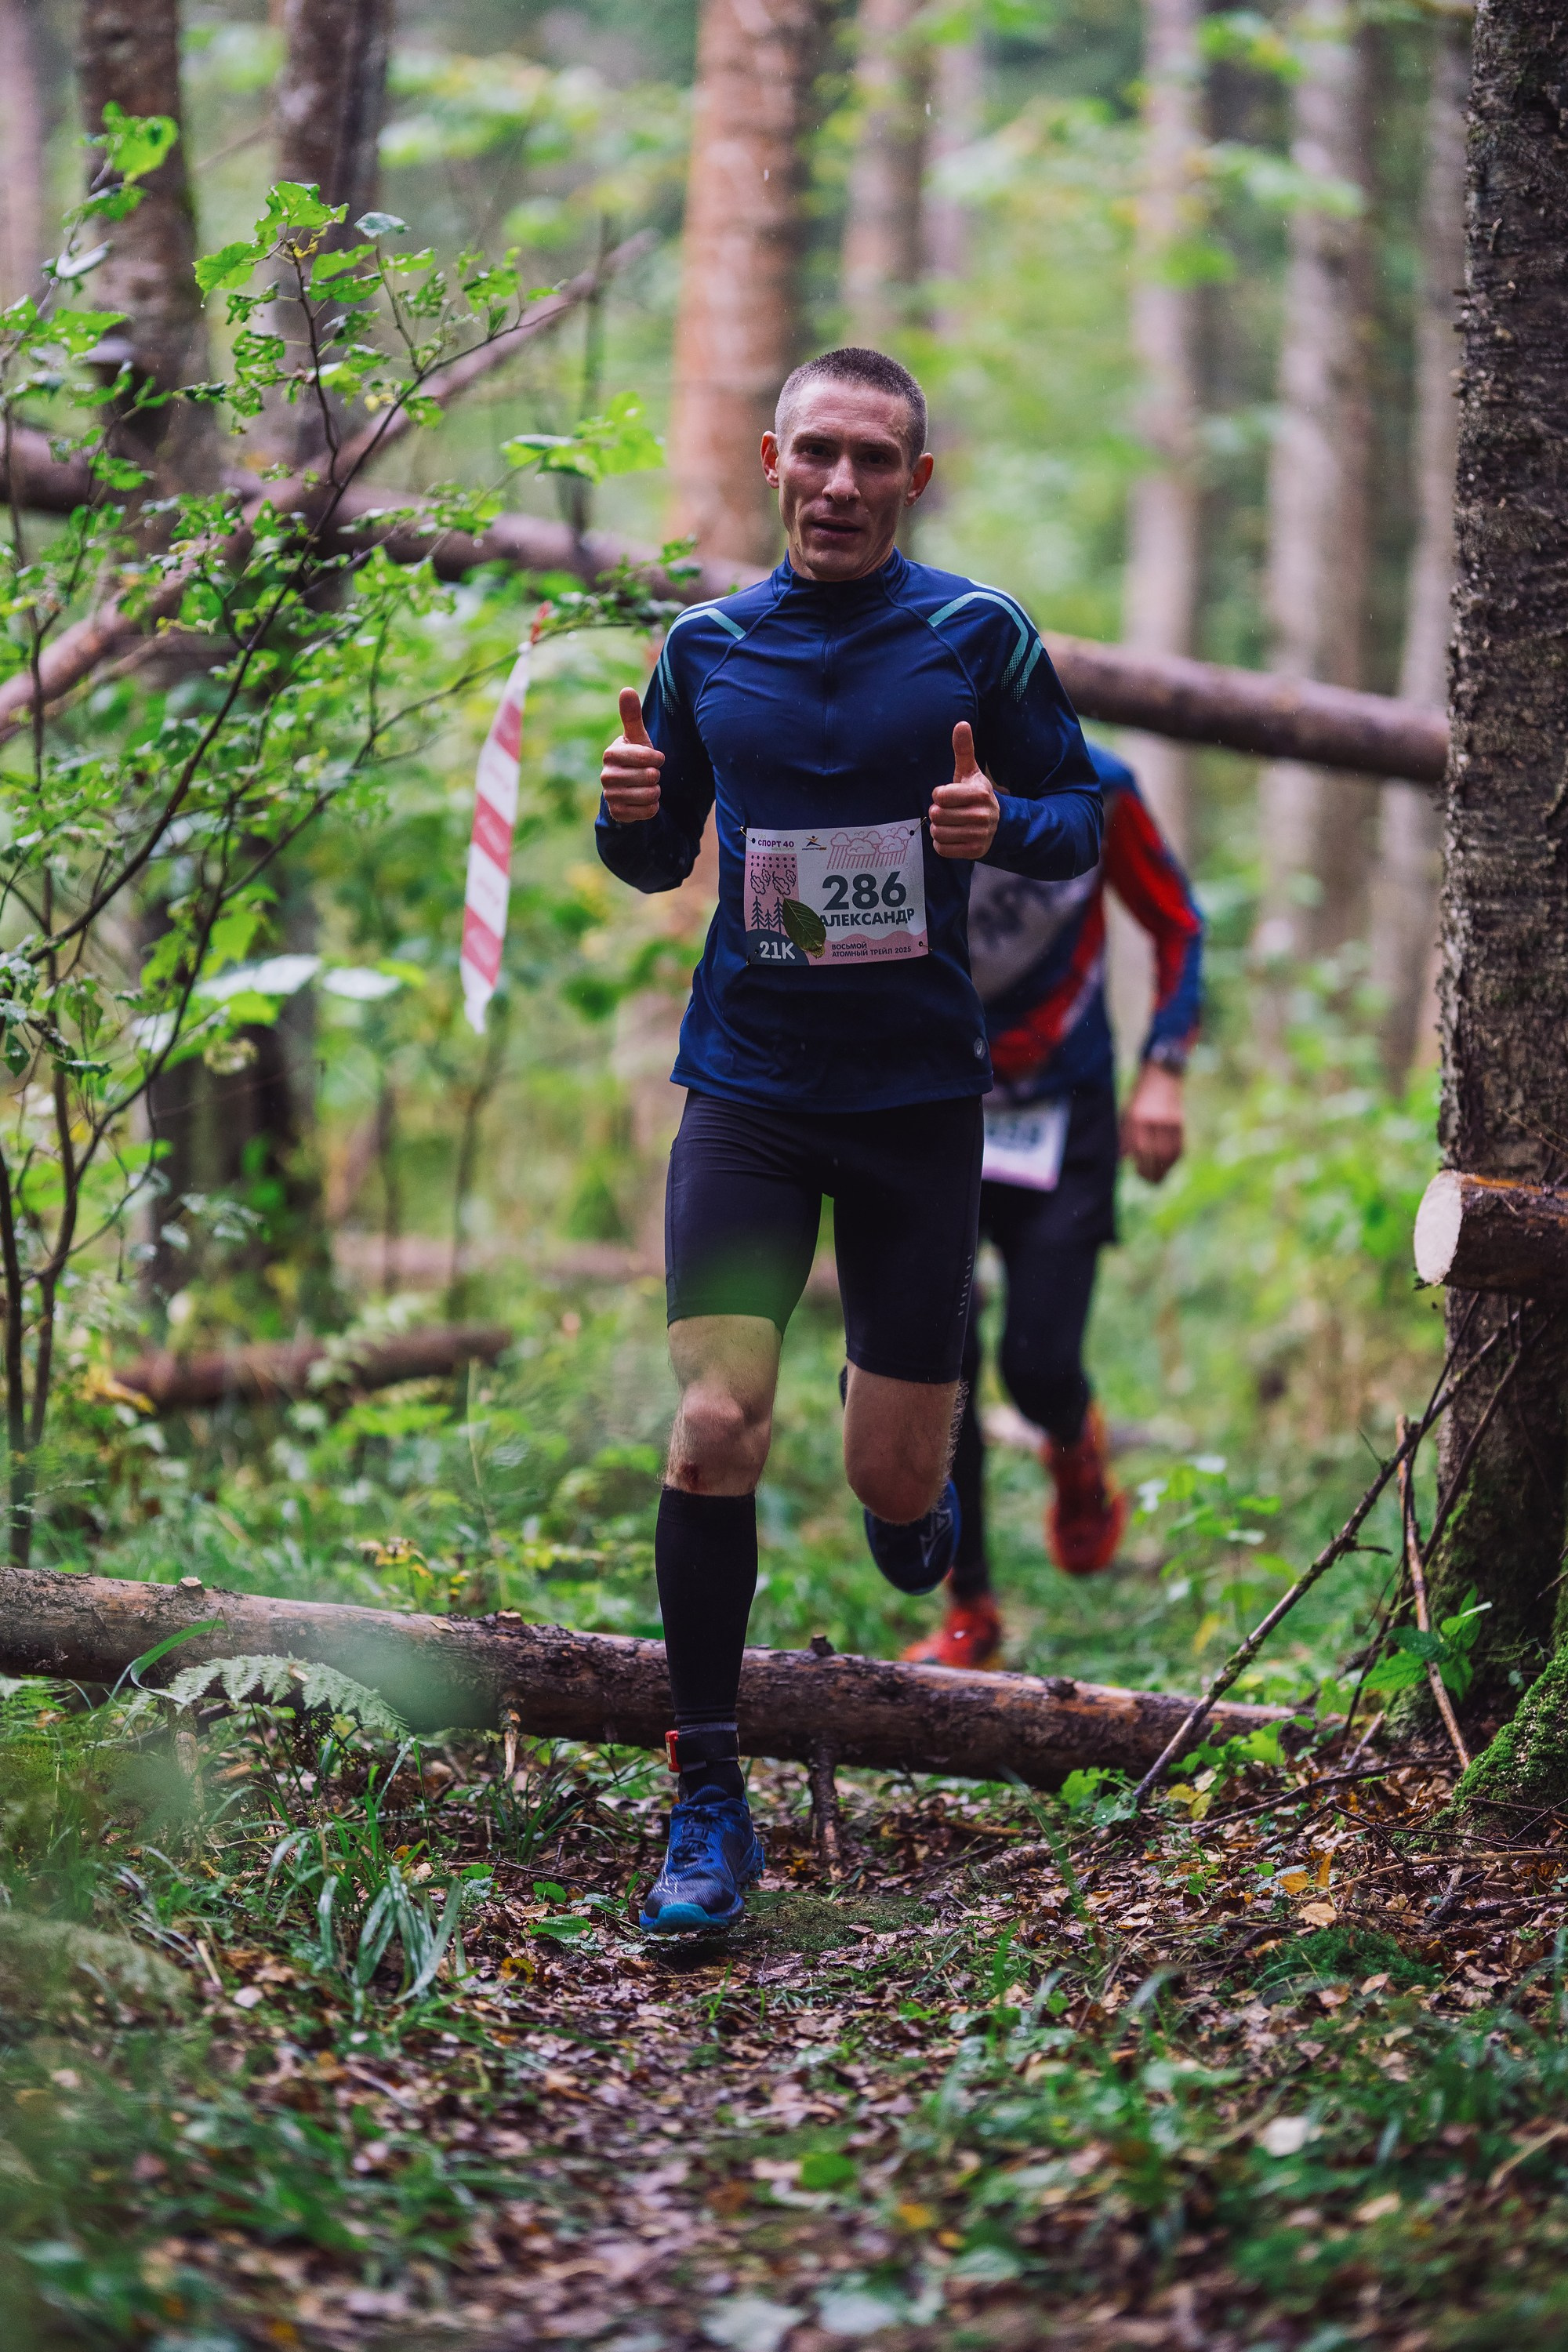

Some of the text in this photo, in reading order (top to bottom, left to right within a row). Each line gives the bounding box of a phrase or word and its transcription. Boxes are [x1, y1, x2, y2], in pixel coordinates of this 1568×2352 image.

[757, 839, 782, 848] СПОРТ
[822, 871, 906, 911] 286
[819, 908, 915, 927] АЛЕКСАНДР
[832, 941, 867, 950] ВОСЬМОЙ
[870, 947, 893, 956] ТРЕЙЛ
